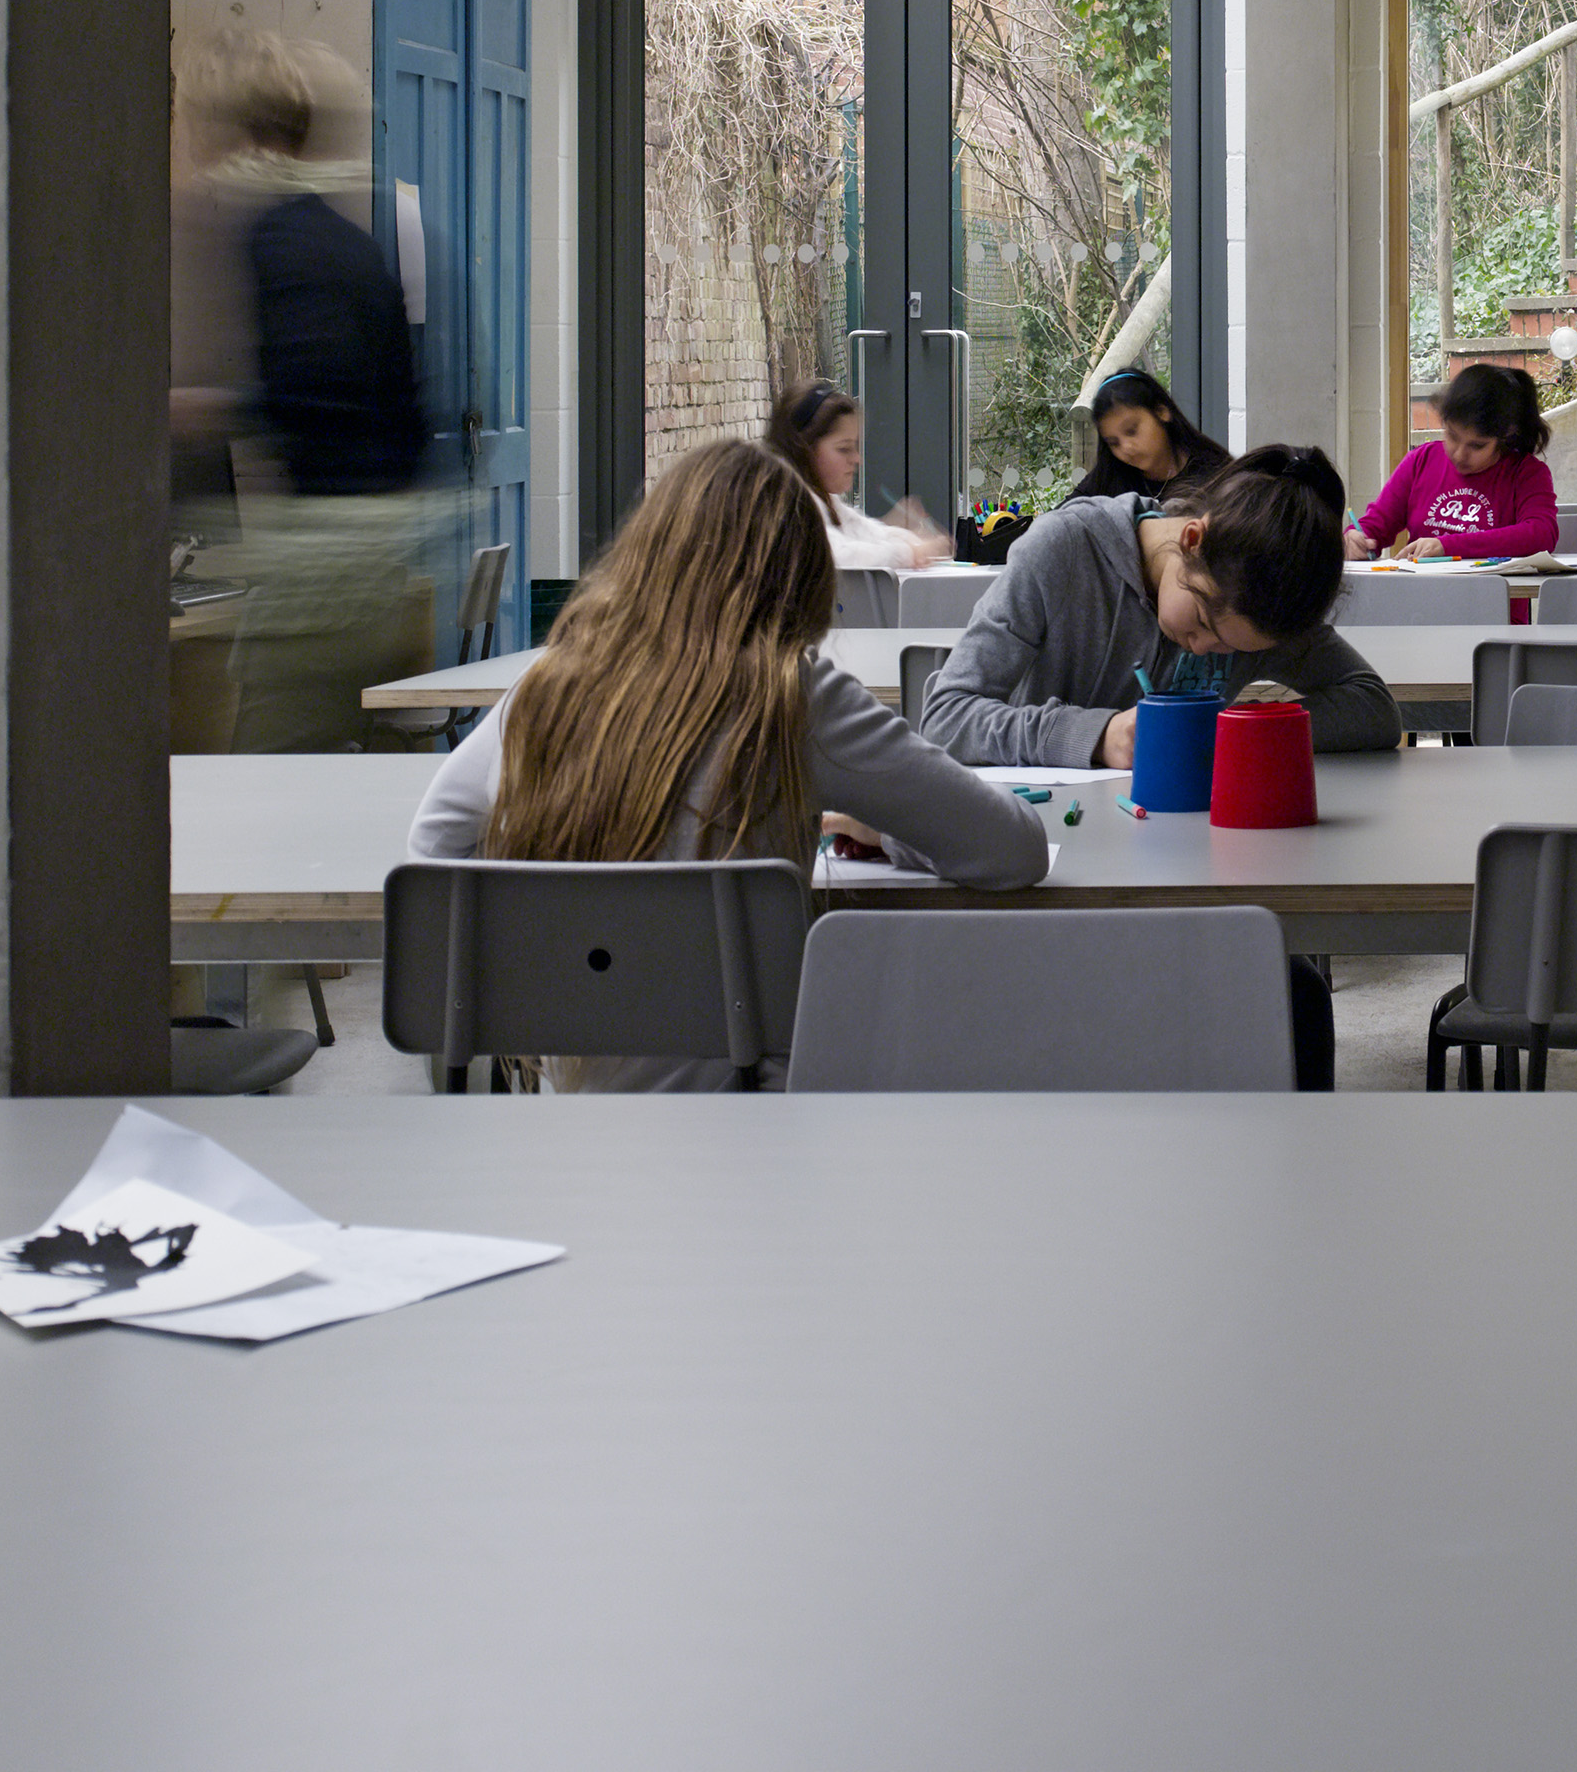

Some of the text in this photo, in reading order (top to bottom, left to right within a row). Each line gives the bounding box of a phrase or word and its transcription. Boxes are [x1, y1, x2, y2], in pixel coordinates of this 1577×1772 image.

[1427, 493, 1448, 517] RALPH
[1447, 487, 1479, 498] LAUREN
[1423, 516, 1466, 533] Authentic
